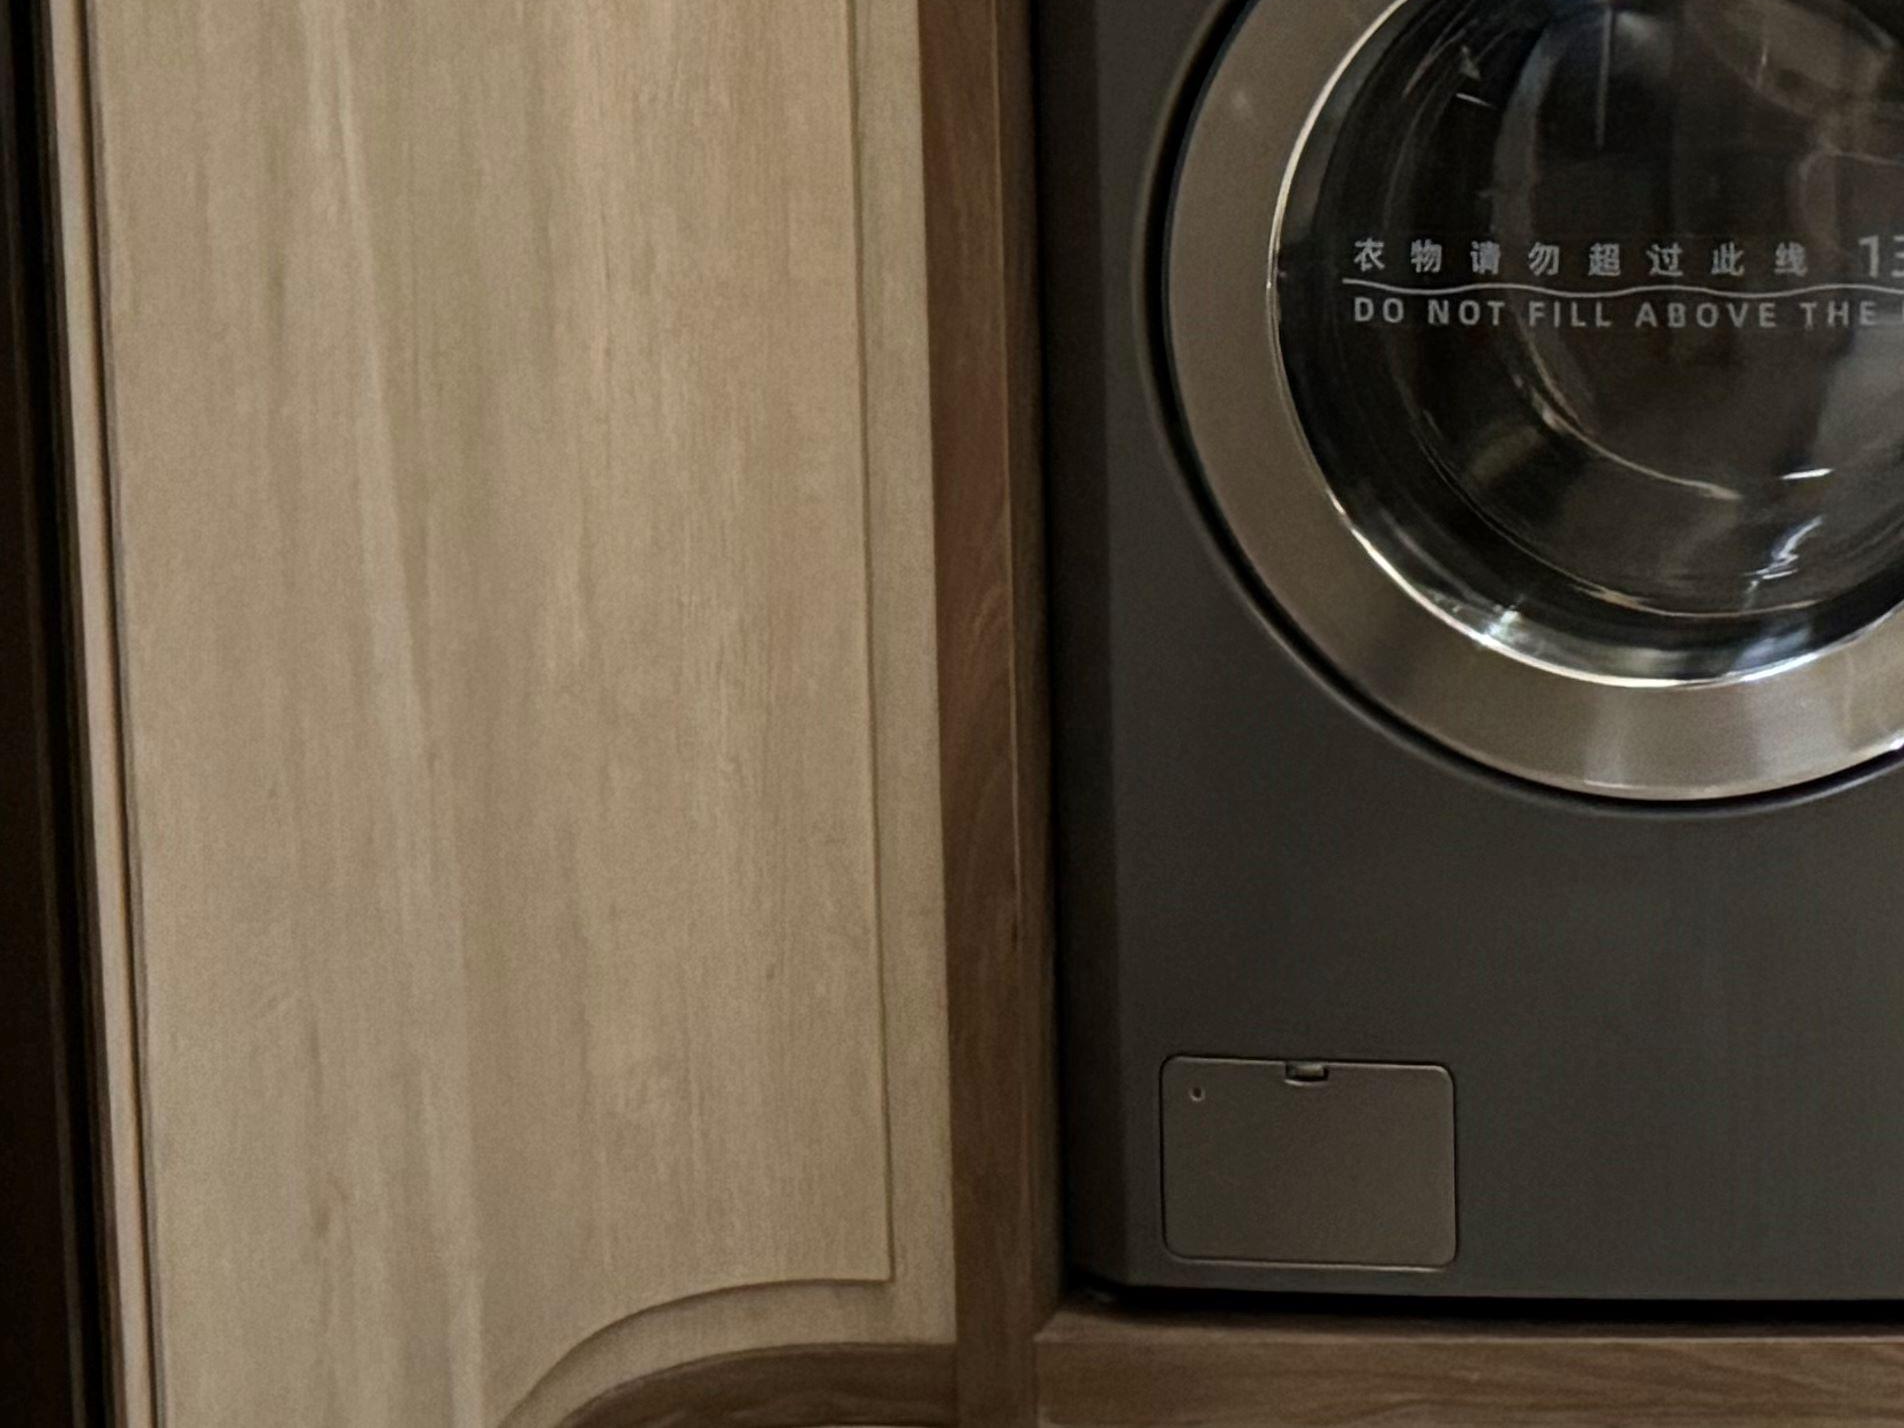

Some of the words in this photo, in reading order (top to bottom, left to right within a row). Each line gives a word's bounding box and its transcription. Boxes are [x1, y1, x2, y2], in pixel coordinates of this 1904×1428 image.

[1355, 238, 1808, 277] 衣物请勿超过此线
[1355, 297, 1403, 322] DO
[1429, 300, 1505, 325] NOT
[1530, 301, 1610, 327] FILL
[1636, 303, 1776, 328] ABOVE
[1801, 302, 1876, 328] THE
